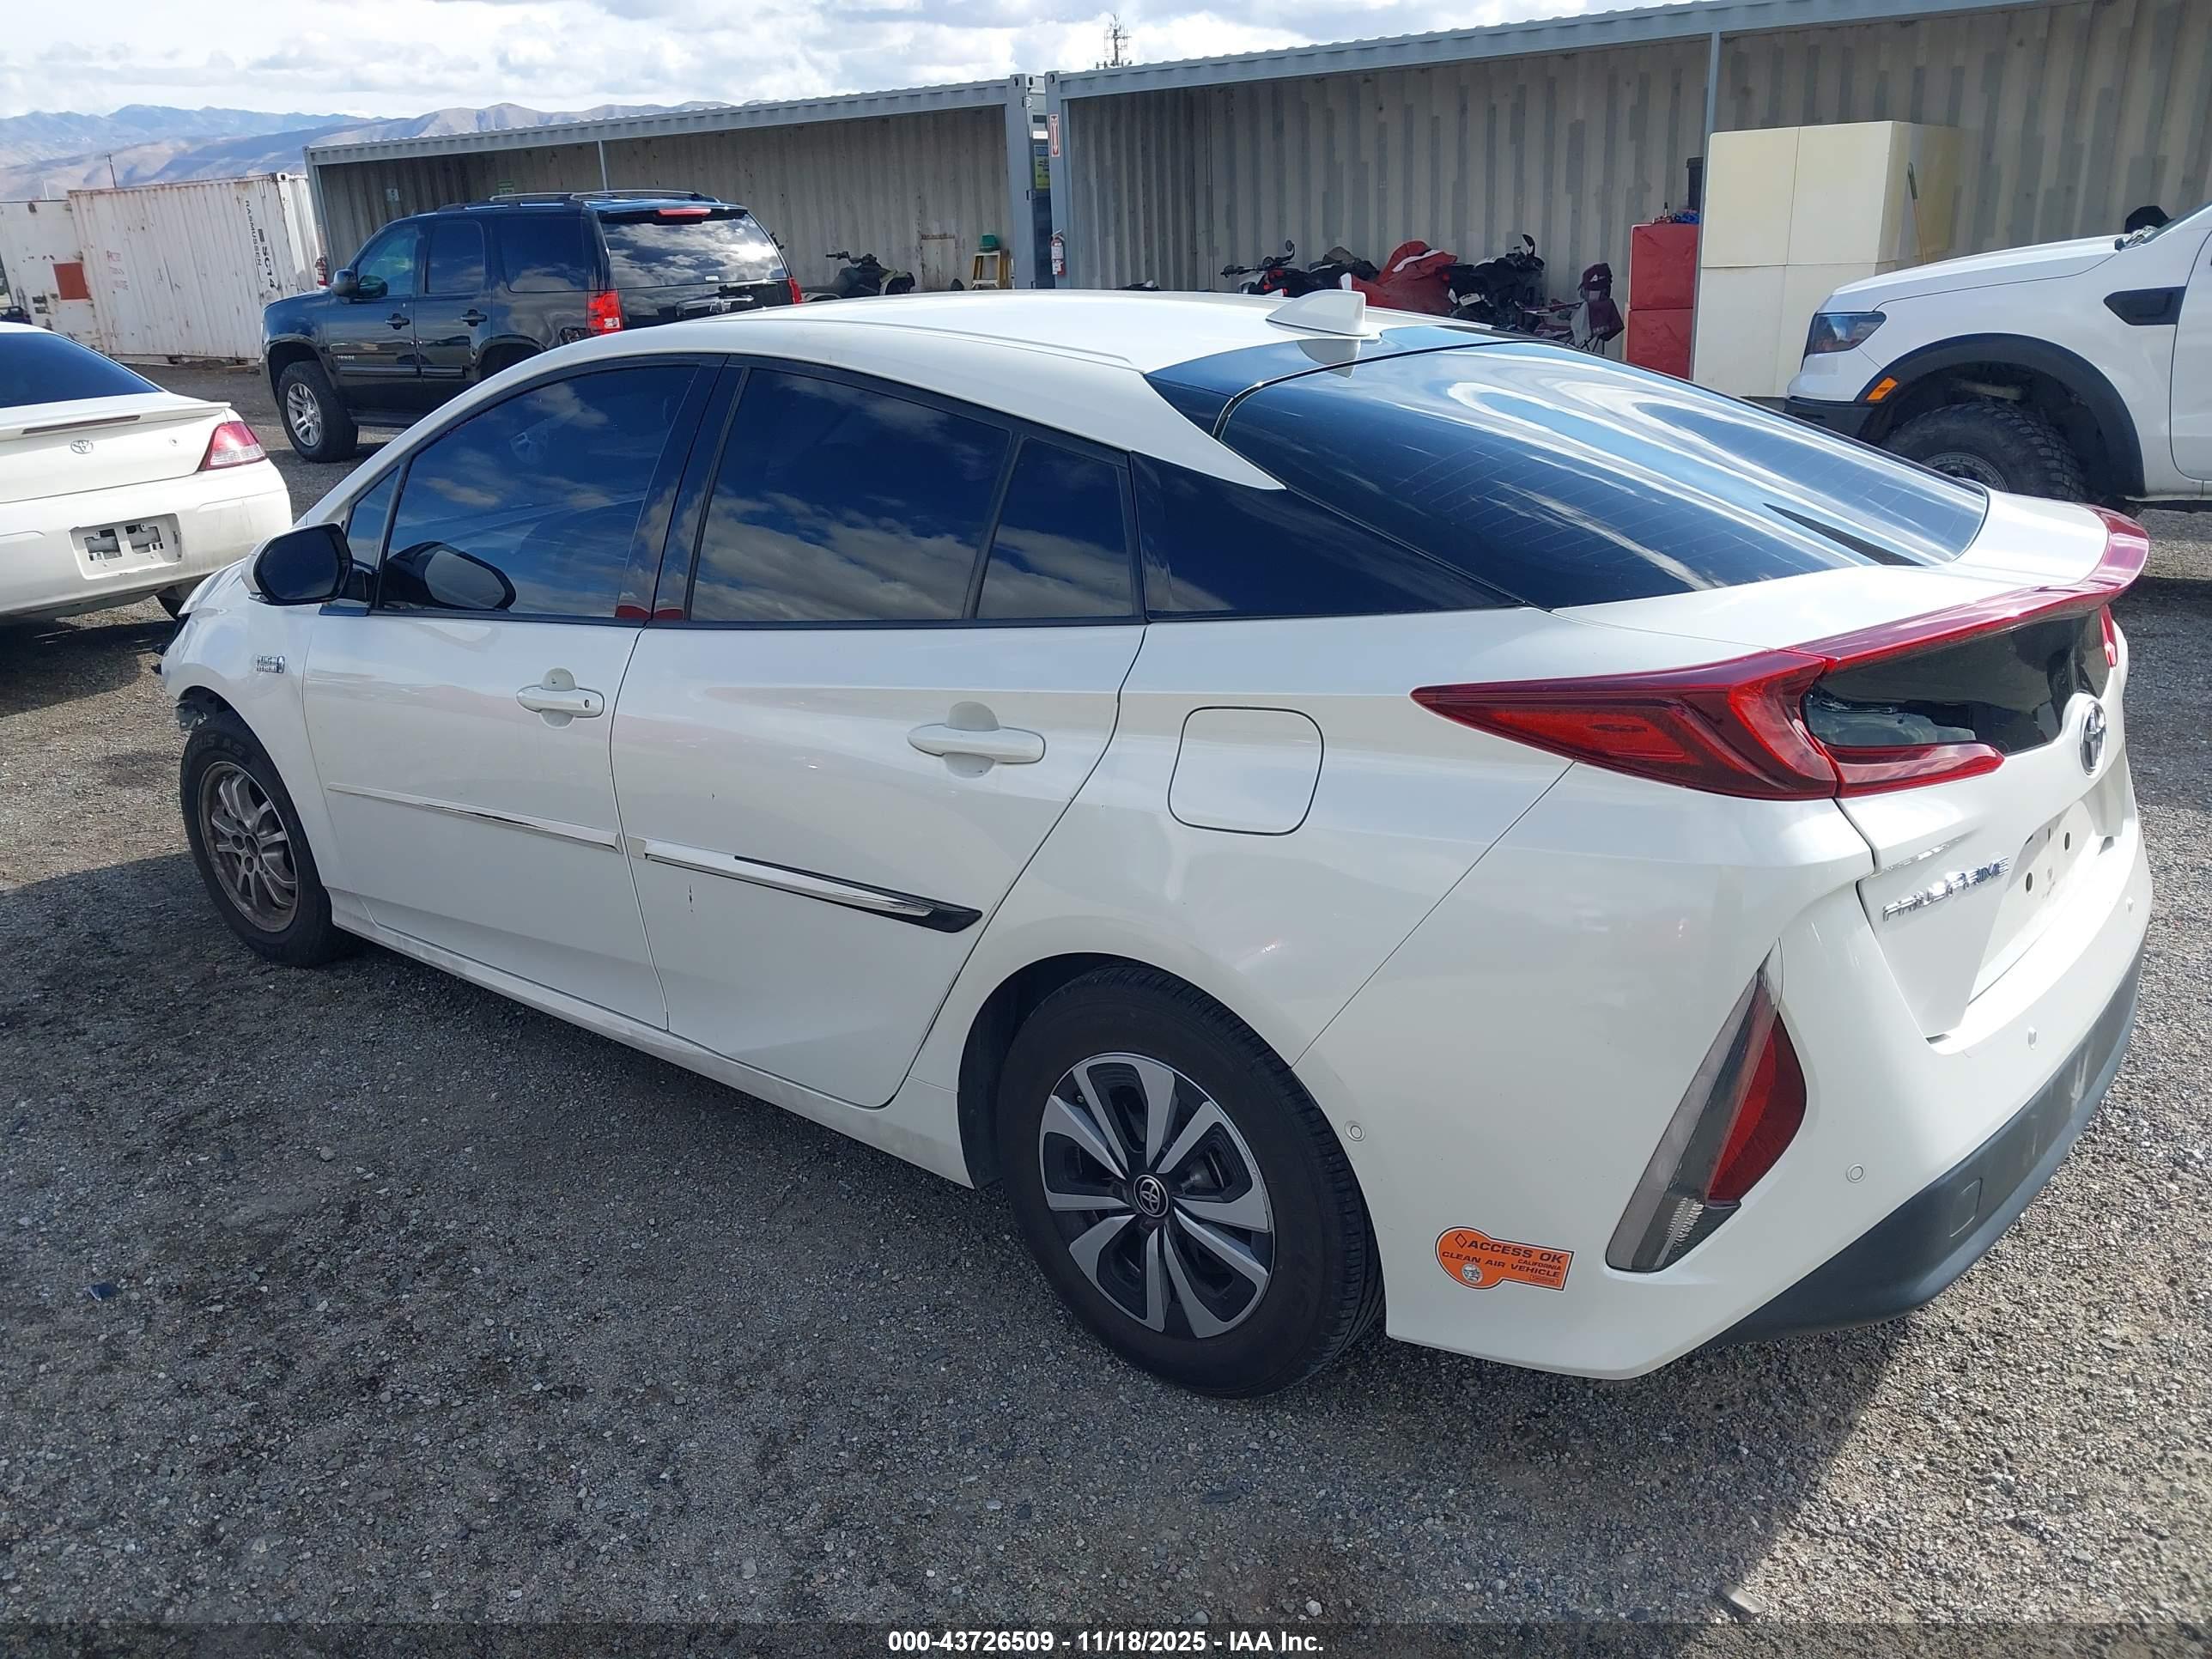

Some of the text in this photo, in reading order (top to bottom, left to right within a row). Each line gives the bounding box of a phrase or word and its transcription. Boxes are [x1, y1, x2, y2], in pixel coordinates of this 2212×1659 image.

[1945, 855, 2009, 897] PRIME
[1442, 1251, 1560, 1278] CLEAN AIR VEHICLE
[1468, 1240, 1565, 1264] ACCESS OK
[1517, 1259, 1561, 1271] CALIFORNIA
